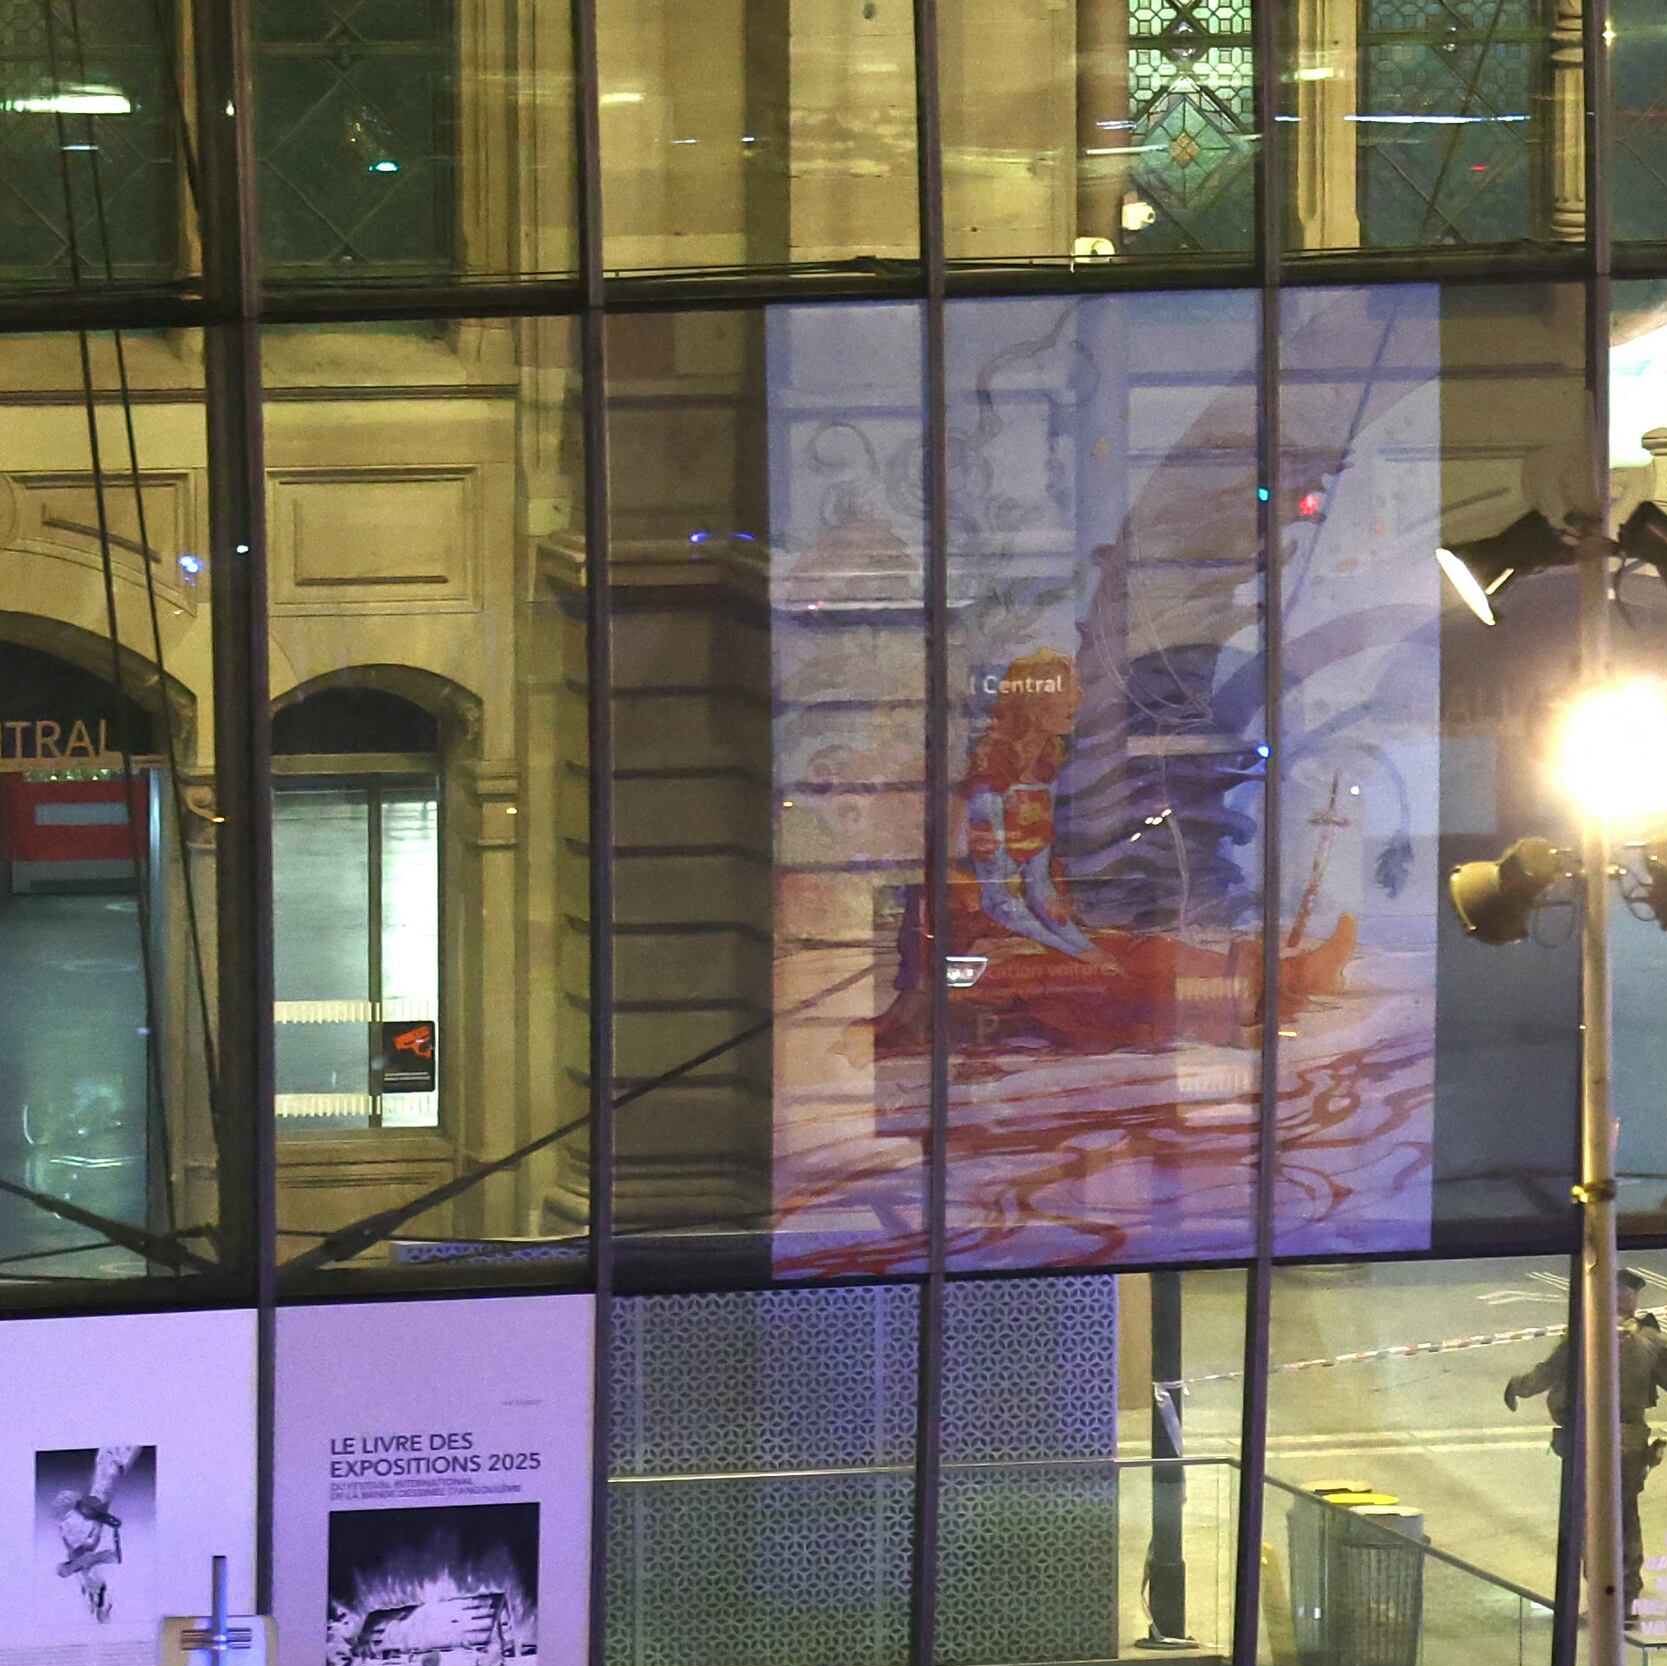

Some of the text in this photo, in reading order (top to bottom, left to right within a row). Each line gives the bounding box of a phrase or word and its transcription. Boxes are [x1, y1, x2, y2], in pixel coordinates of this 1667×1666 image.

[983, 675, 1064, 694] Central
[0, 719, 122, 760] TRAL
[331, 1432, 473, 1455] LE LIVRE DES
[331, 1452, 541, 1478] EXPOSITIONS 2025
